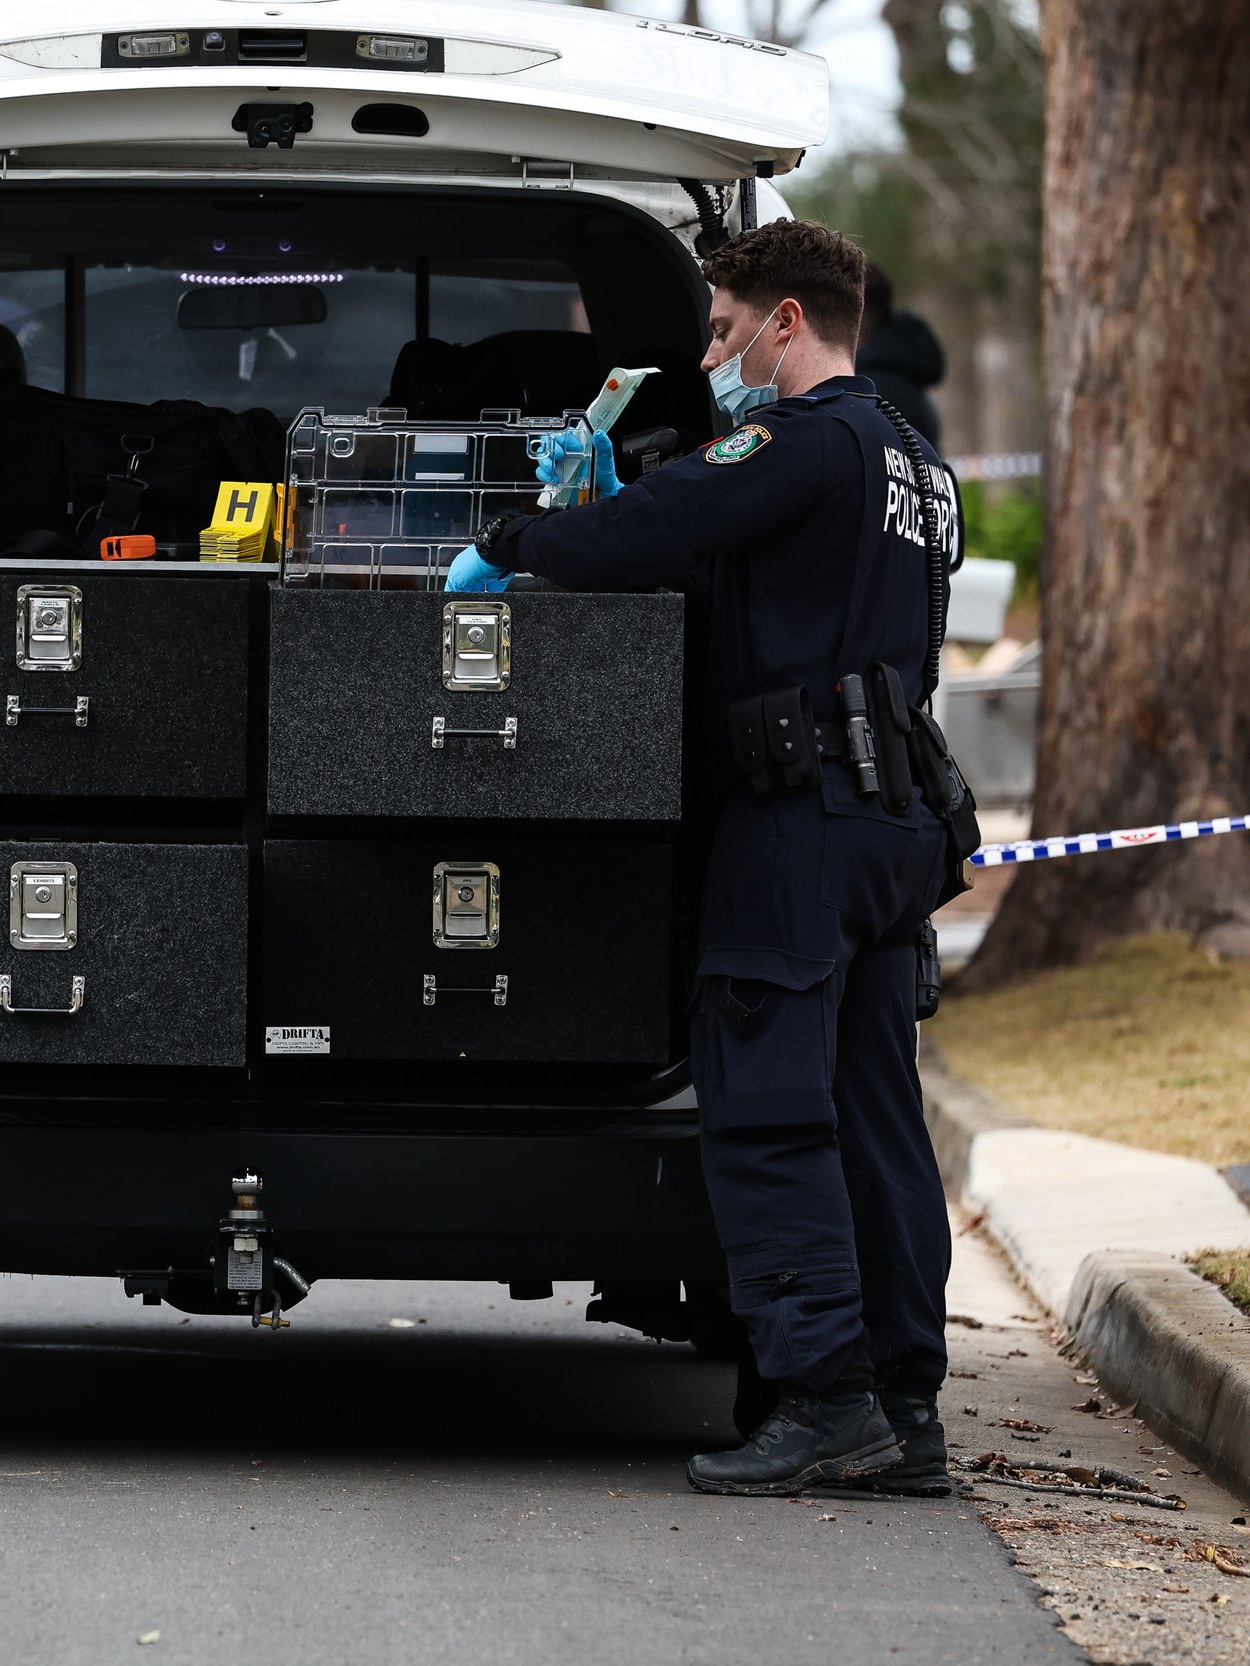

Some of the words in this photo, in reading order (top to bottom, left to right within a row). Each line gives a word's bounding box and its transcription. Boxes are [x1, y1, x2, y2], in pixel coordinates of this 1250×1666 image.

[883, 446, 907, 481] NEW
[226, 490, 258, 522] H
[883, 481, 925, 547] POLICE
[282, 1029, 324, 1040] DRIFTA
